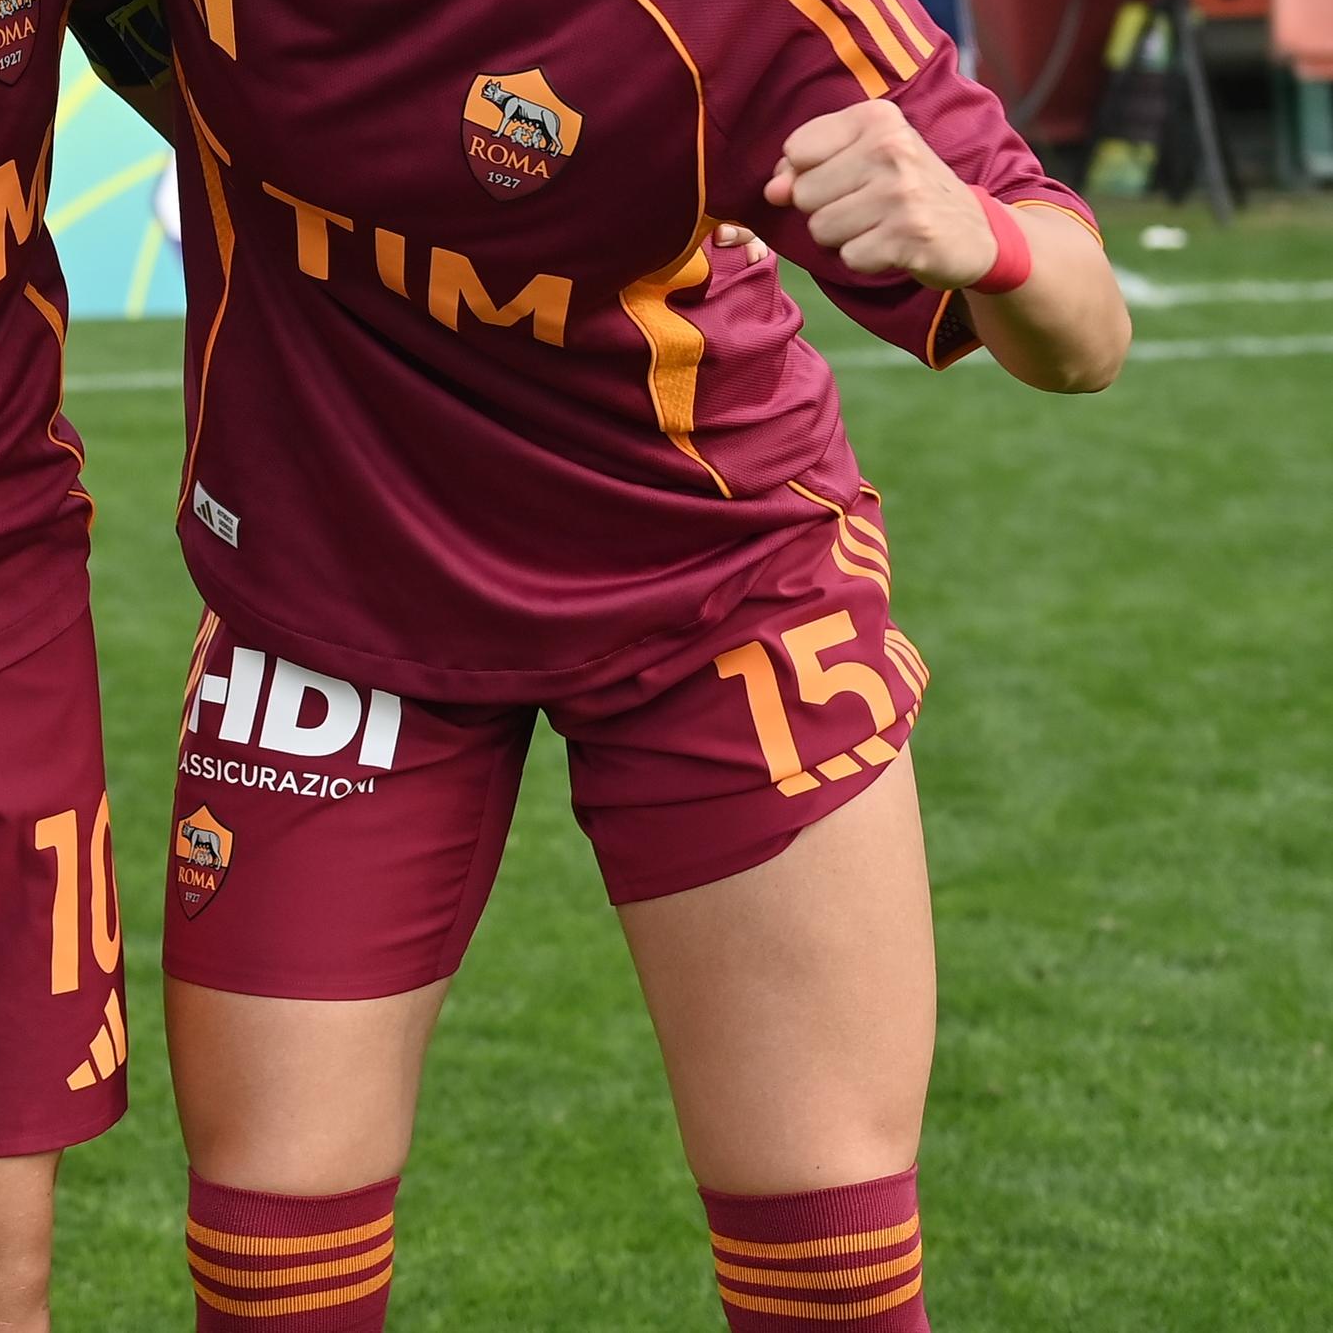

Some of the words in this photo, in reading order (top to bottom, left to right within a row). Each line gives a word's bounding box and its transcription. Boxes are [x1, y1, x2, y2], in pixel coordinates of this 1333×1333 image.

[0, 50, 22, 70] 1927
[468, 135, 551, 179] ROMA
[487, 171, 521, 189] 1927
[262, 181, 573, 348] TIM
[187, 646, 402, 771] HDI
[712, 609, 897, 784] 15
[179, 750, 375, 800] ASSICURAZIONI
[34, 789, 121, 996] 10
[177, 865, 216, 891] ROMA
